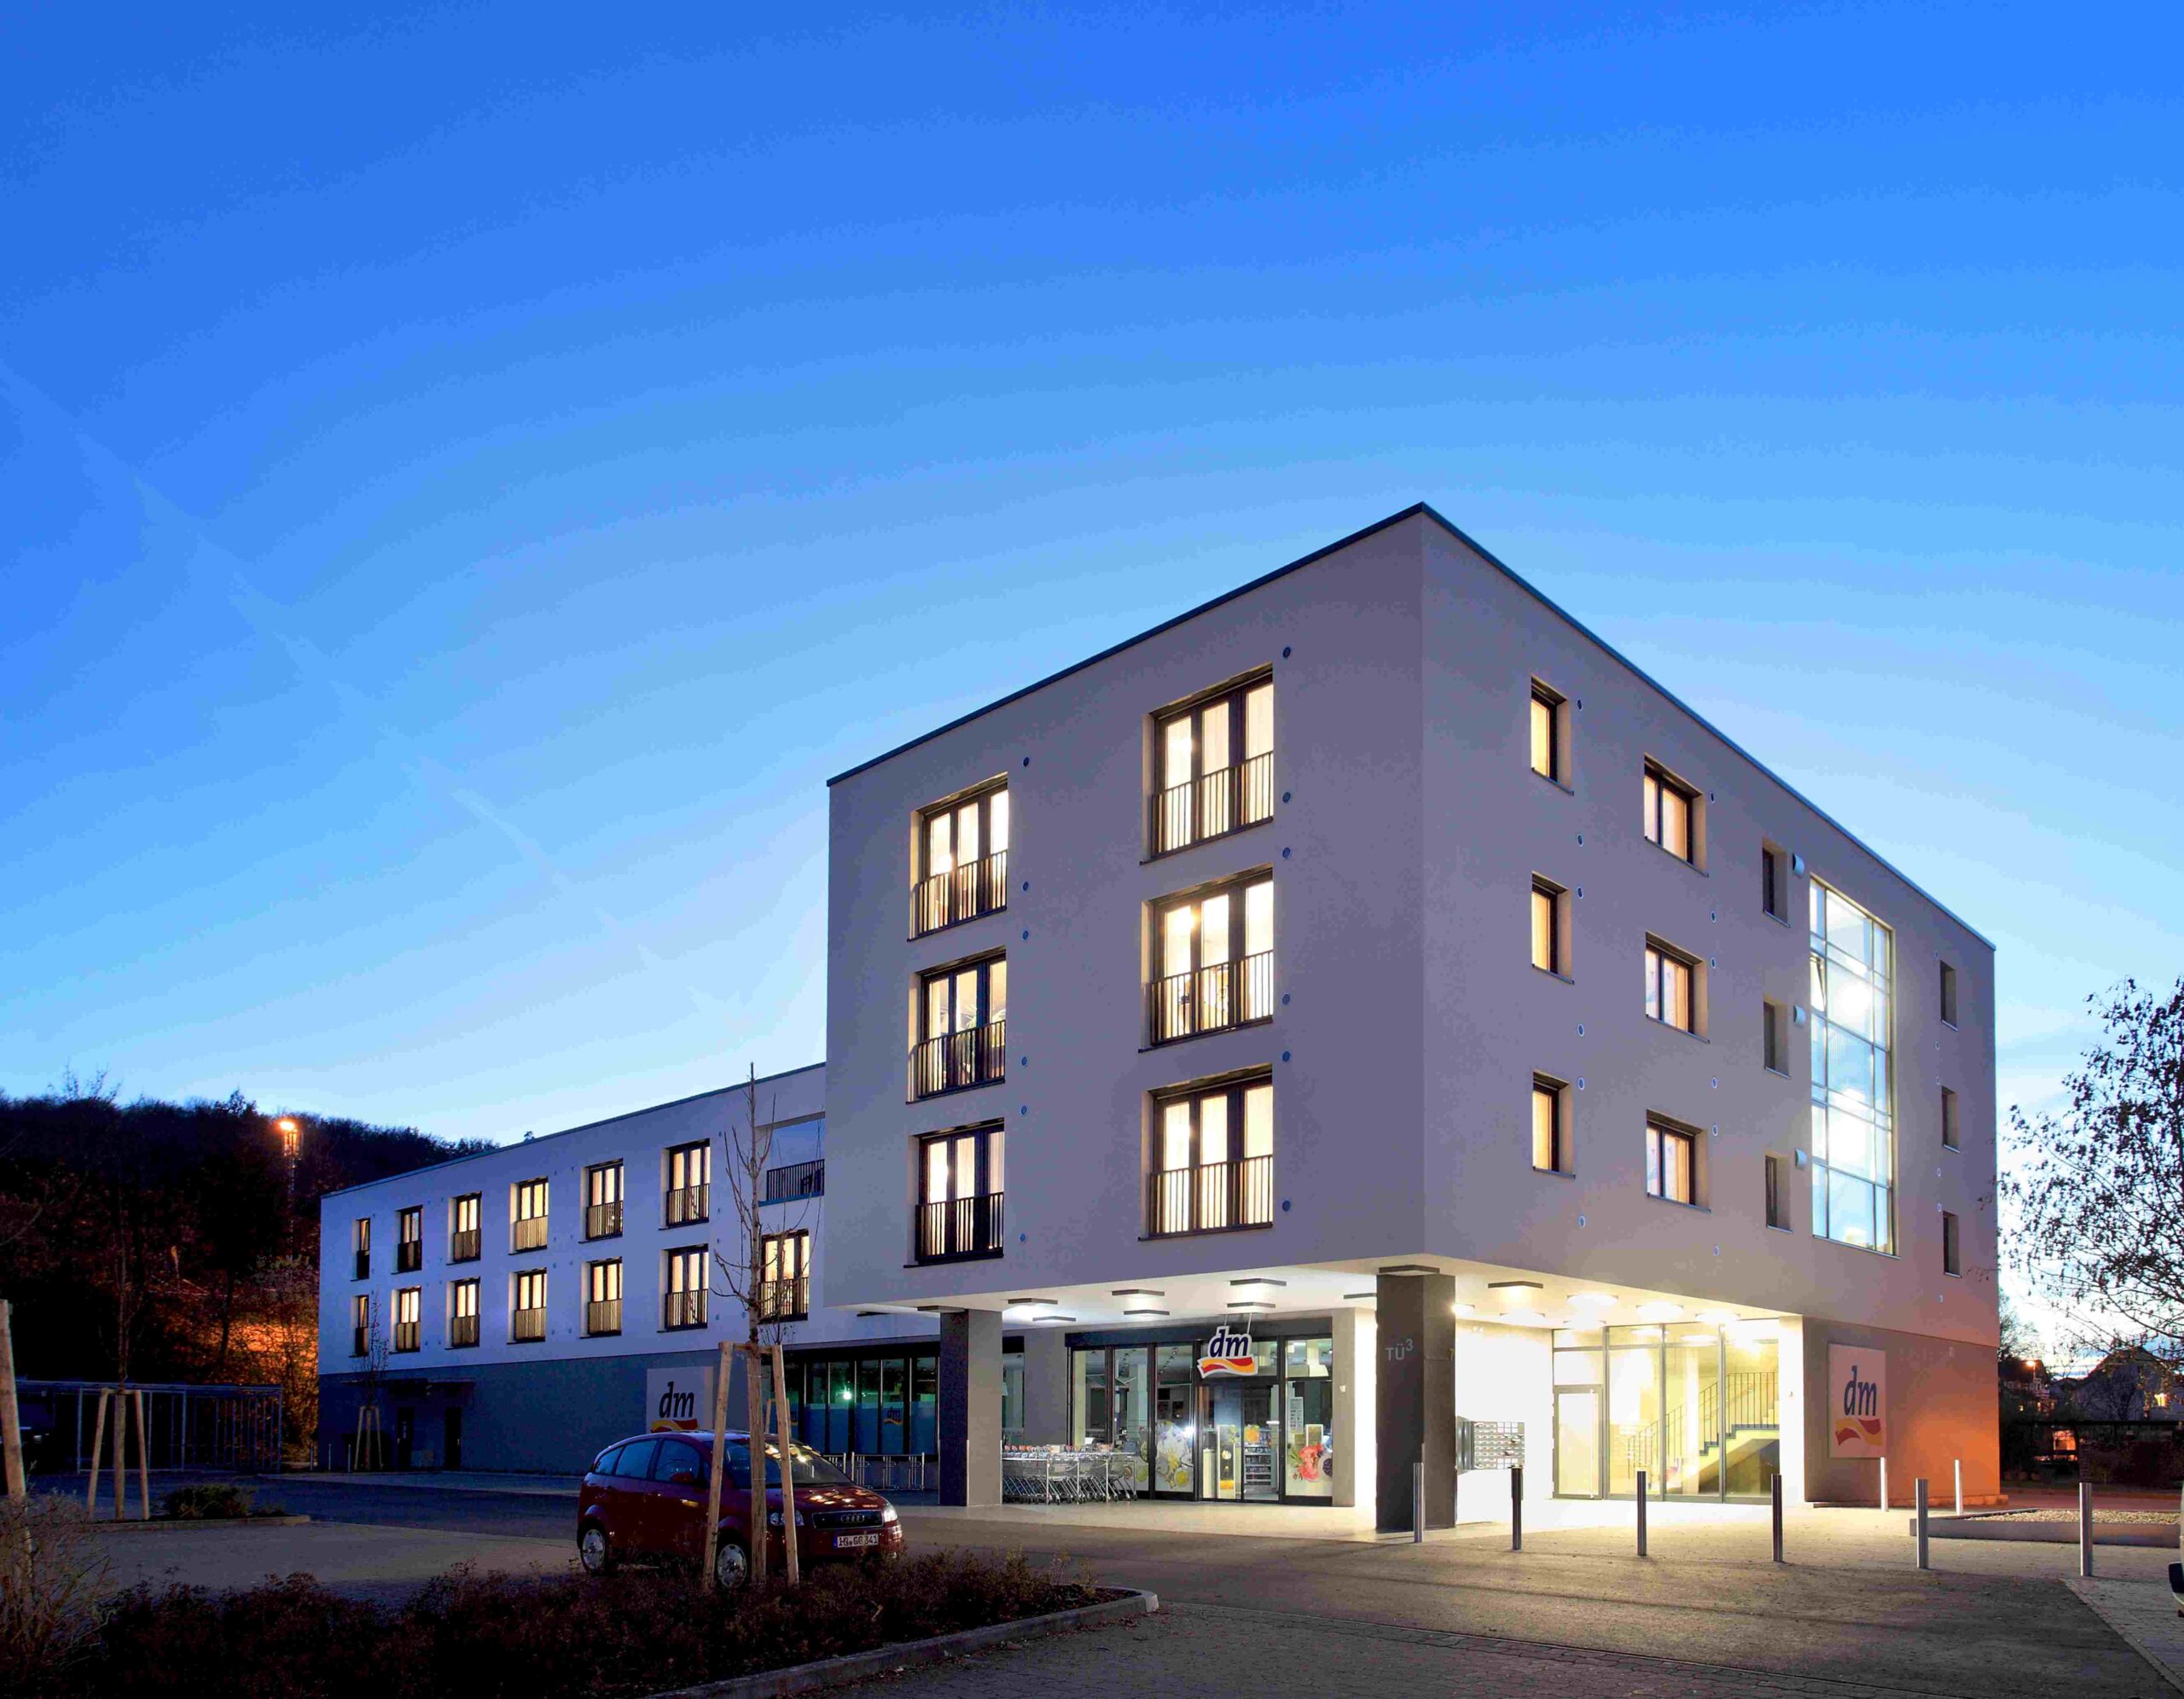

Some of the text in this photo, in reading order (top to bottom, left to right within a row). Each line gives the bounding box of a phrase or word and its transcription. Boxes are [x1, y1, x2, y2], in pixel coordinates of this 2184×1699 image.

[1210, 1329, 1249, 1358] dm
[659, 1381, 694, 1418] dm
[1844, 1365, 1877, 1417] dm
